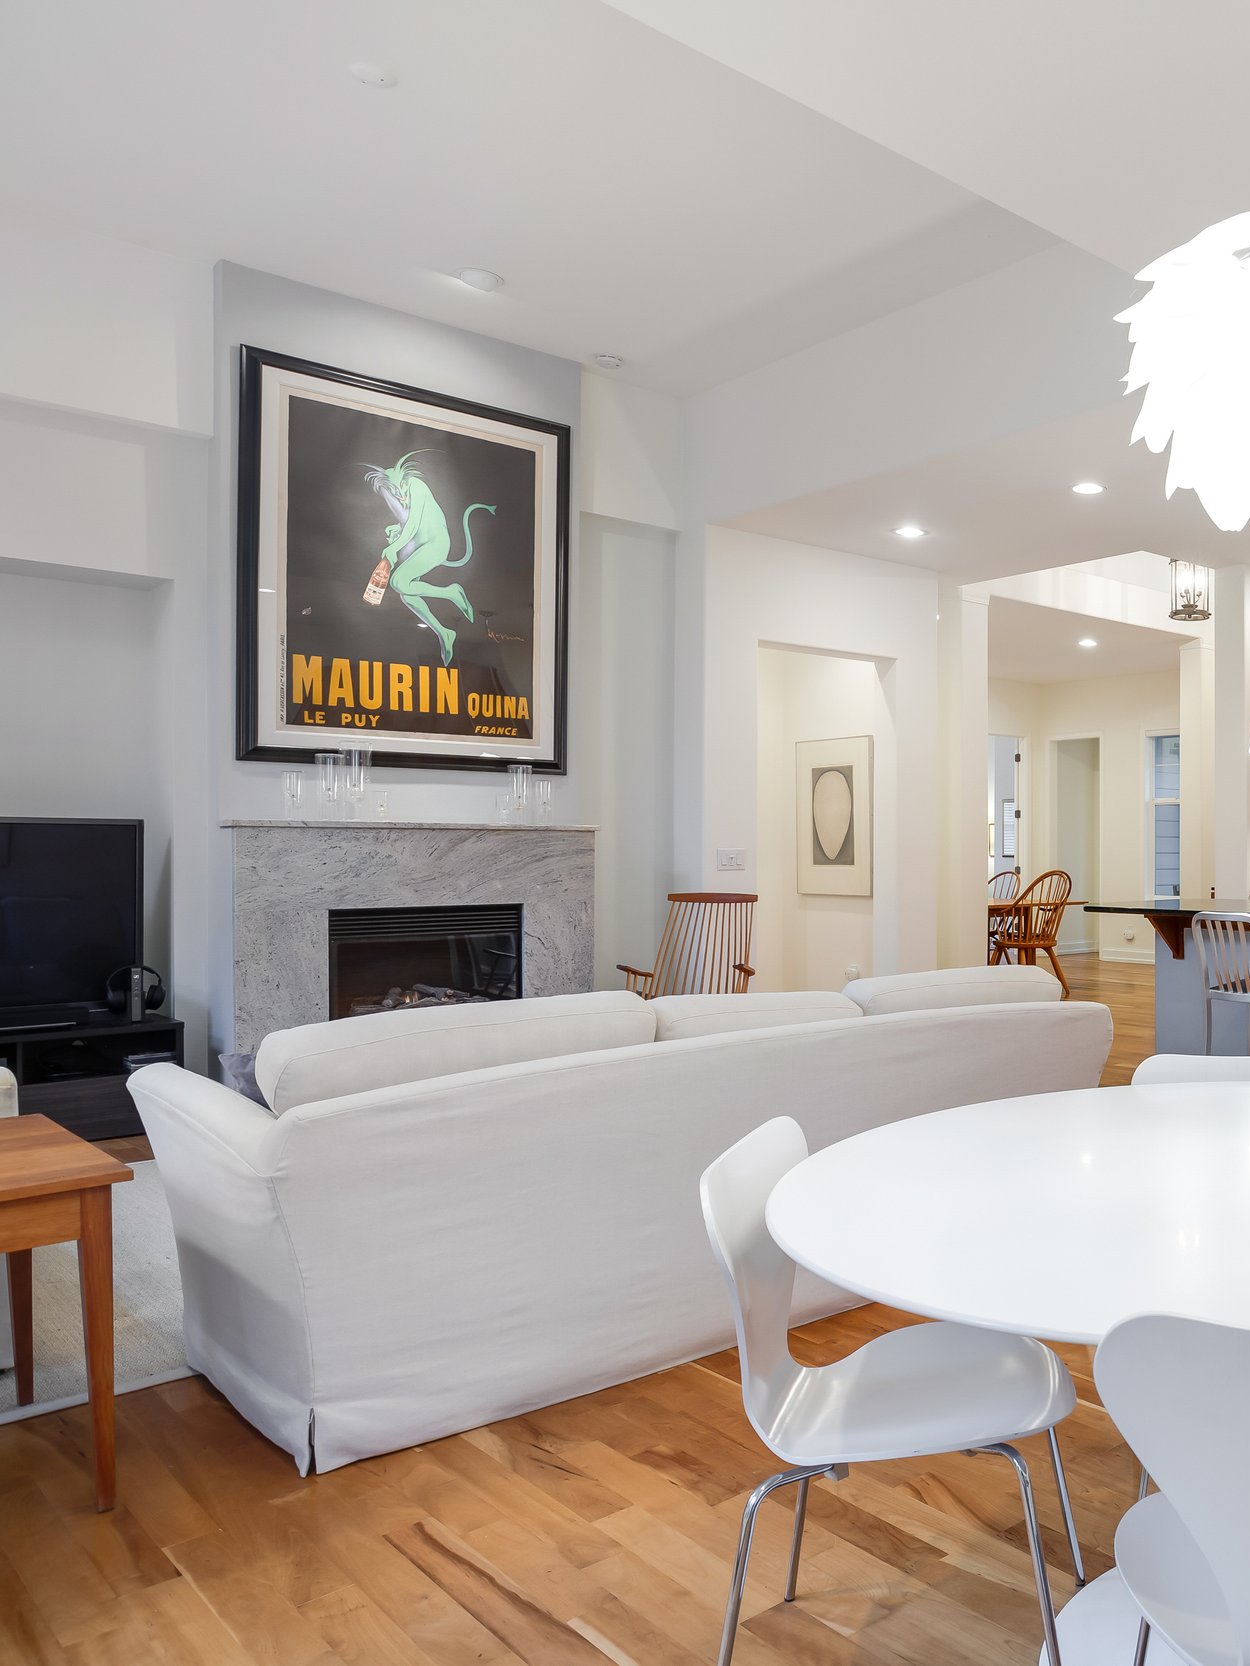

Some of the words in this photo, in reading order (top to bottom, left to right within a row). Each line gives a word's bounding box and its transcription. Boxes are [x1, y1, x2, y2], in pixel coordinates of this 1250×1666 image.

[292, 654, 459, 715] MAURIN
[467, 692, 530, 720] QUINA
[303, 710, 326, 725] LE
[341, 712, 381, 728] PUY
[474, 725, 518, 736] FRANCE
